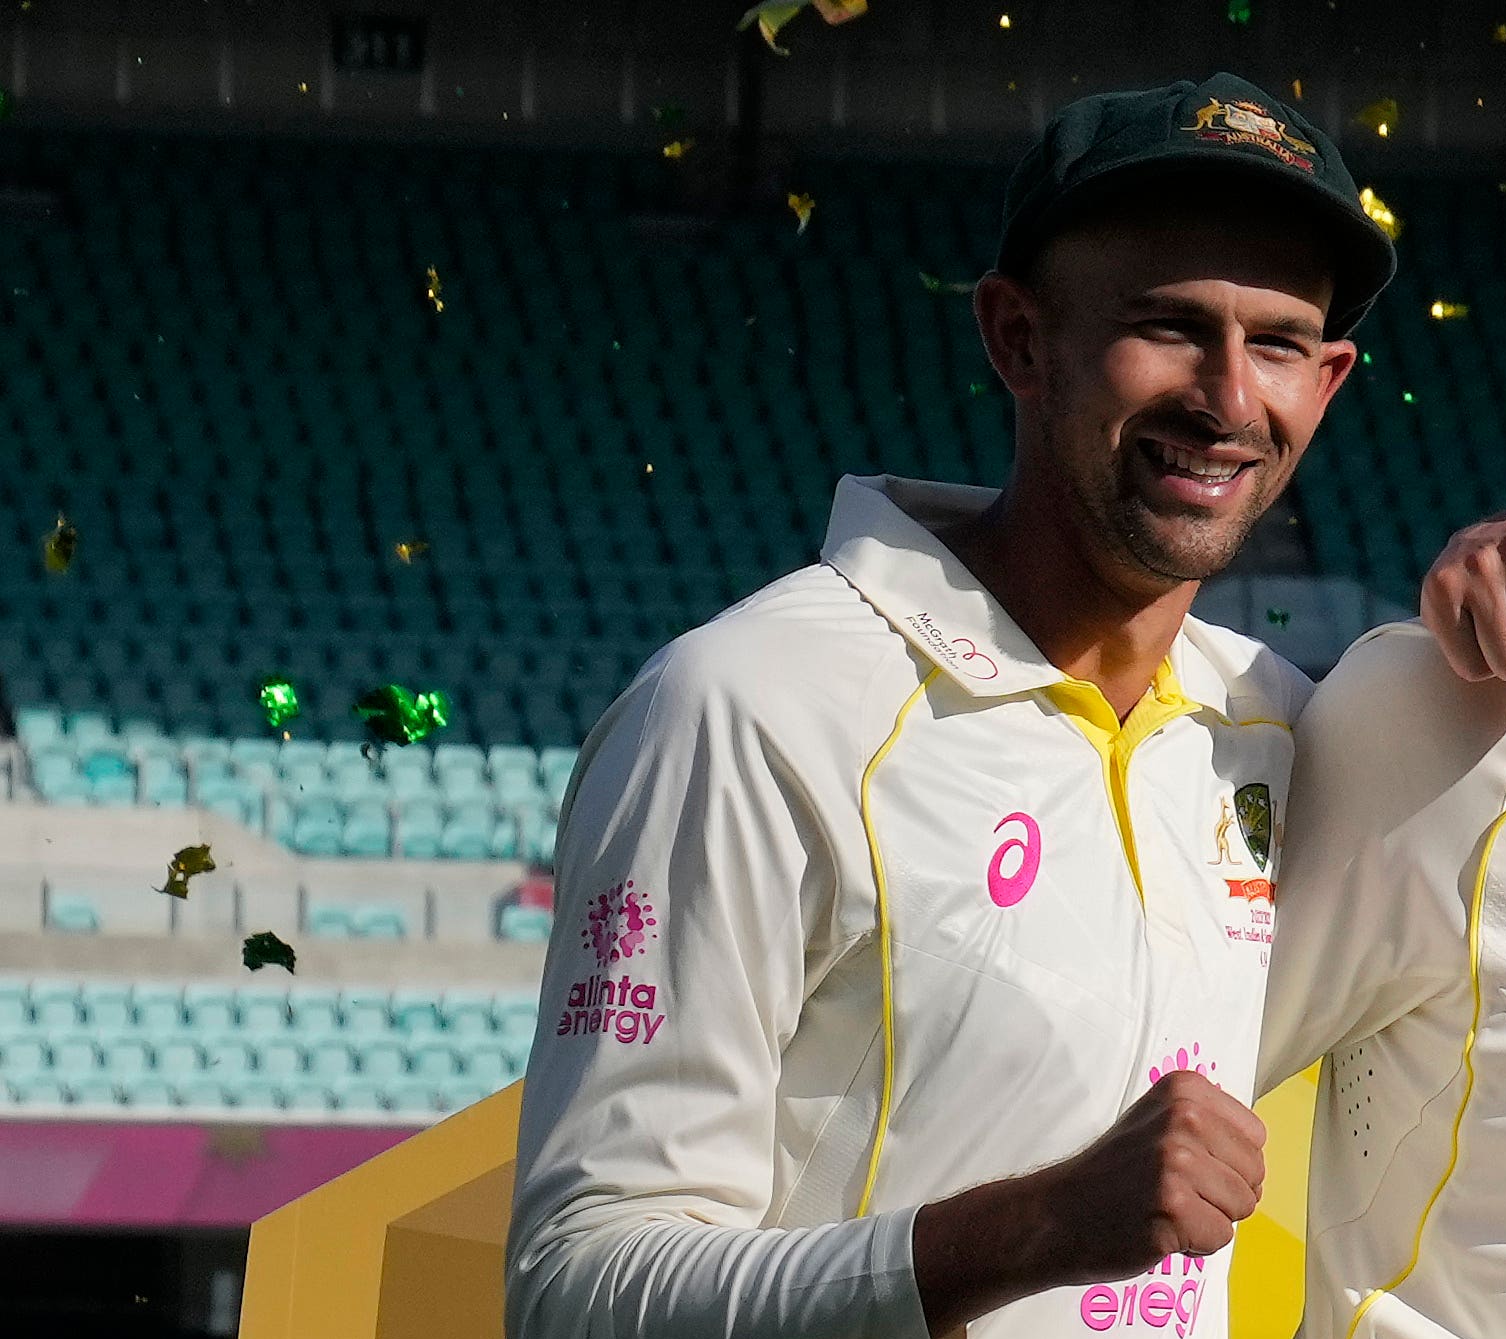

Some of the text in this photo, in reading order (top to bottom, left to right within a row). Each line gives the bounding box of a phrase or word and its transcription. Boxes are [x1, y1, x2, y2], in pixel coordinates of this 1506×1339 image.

[905, 615, 960, 670] Foundation
[917, 612, 958, 660] McGrath
[568, 974, 658, 1010] alinta
[557, 1007, 667, 1045] energy
